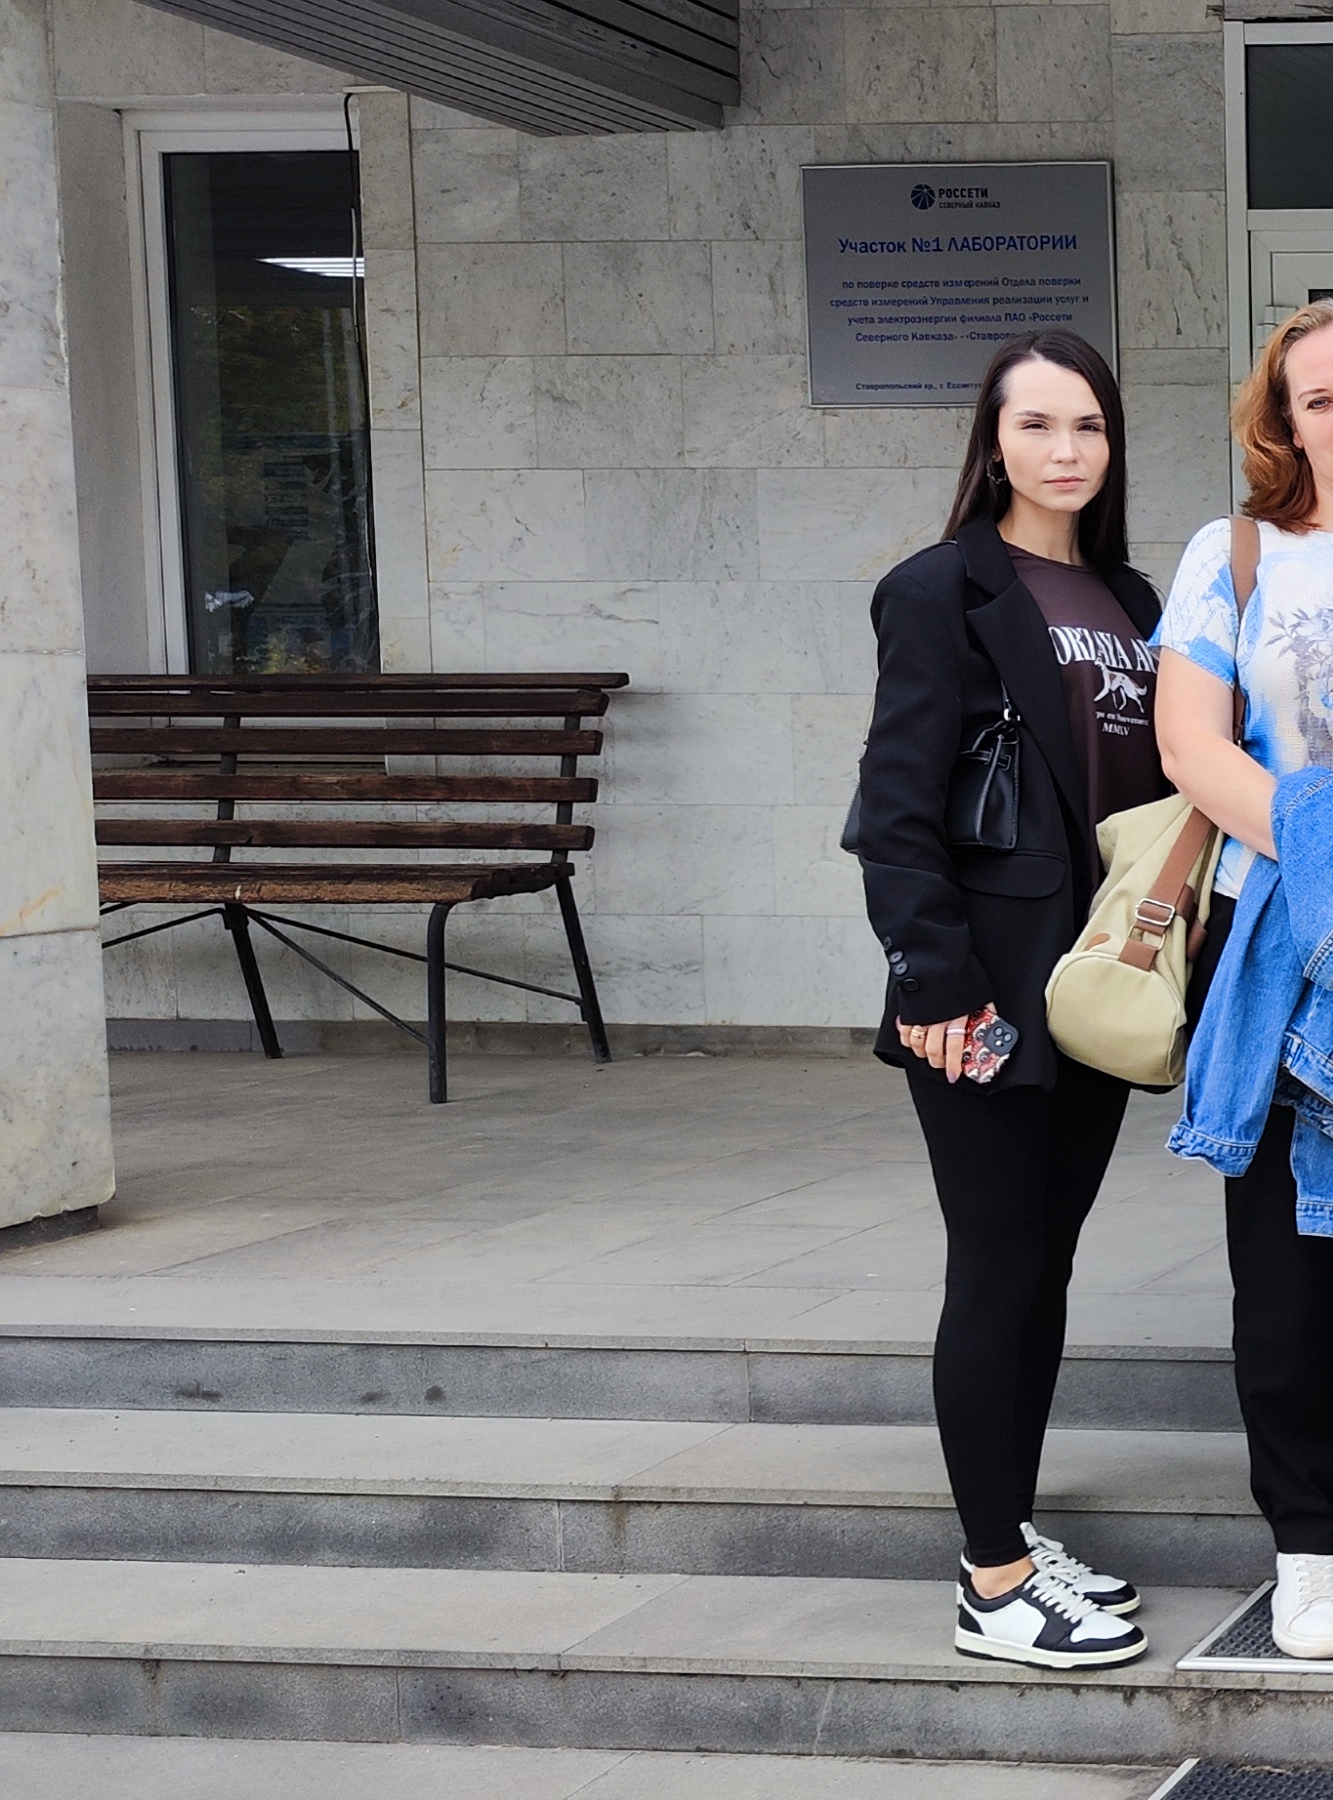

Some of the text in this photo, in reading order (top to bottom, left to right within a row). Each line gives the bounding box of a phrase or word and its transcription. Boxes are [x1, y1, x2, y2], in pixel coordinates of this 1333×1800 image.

[938, 187, 988, 199] РОССЕТИ
[939, 200, 973, 209] СЕВЕРНЫЙ
[838, 234, 1077, 253] Участок №1 ЛАБОРАТОРИИ
[842, 276, 1082, 290] по поверке средств измерений Отдела поверки
[830, 299, 869, 309] средств
[871, 296, 928, 308] измерений
[930, 296, 990, 307] Управления
[992, 296, 1053, 306] реализации
[1055, 295, 1080, 306] услуг
[847, 316, 875, 326] учета
[877, 315, 957, 325] электроэнергии
[959, 314, 1002, 325] филиала
[1004, 312, 1026, 322] ПАО
[855, 332, 909, 343] Северного
[855, 382, 922, 391] Ставропольский
